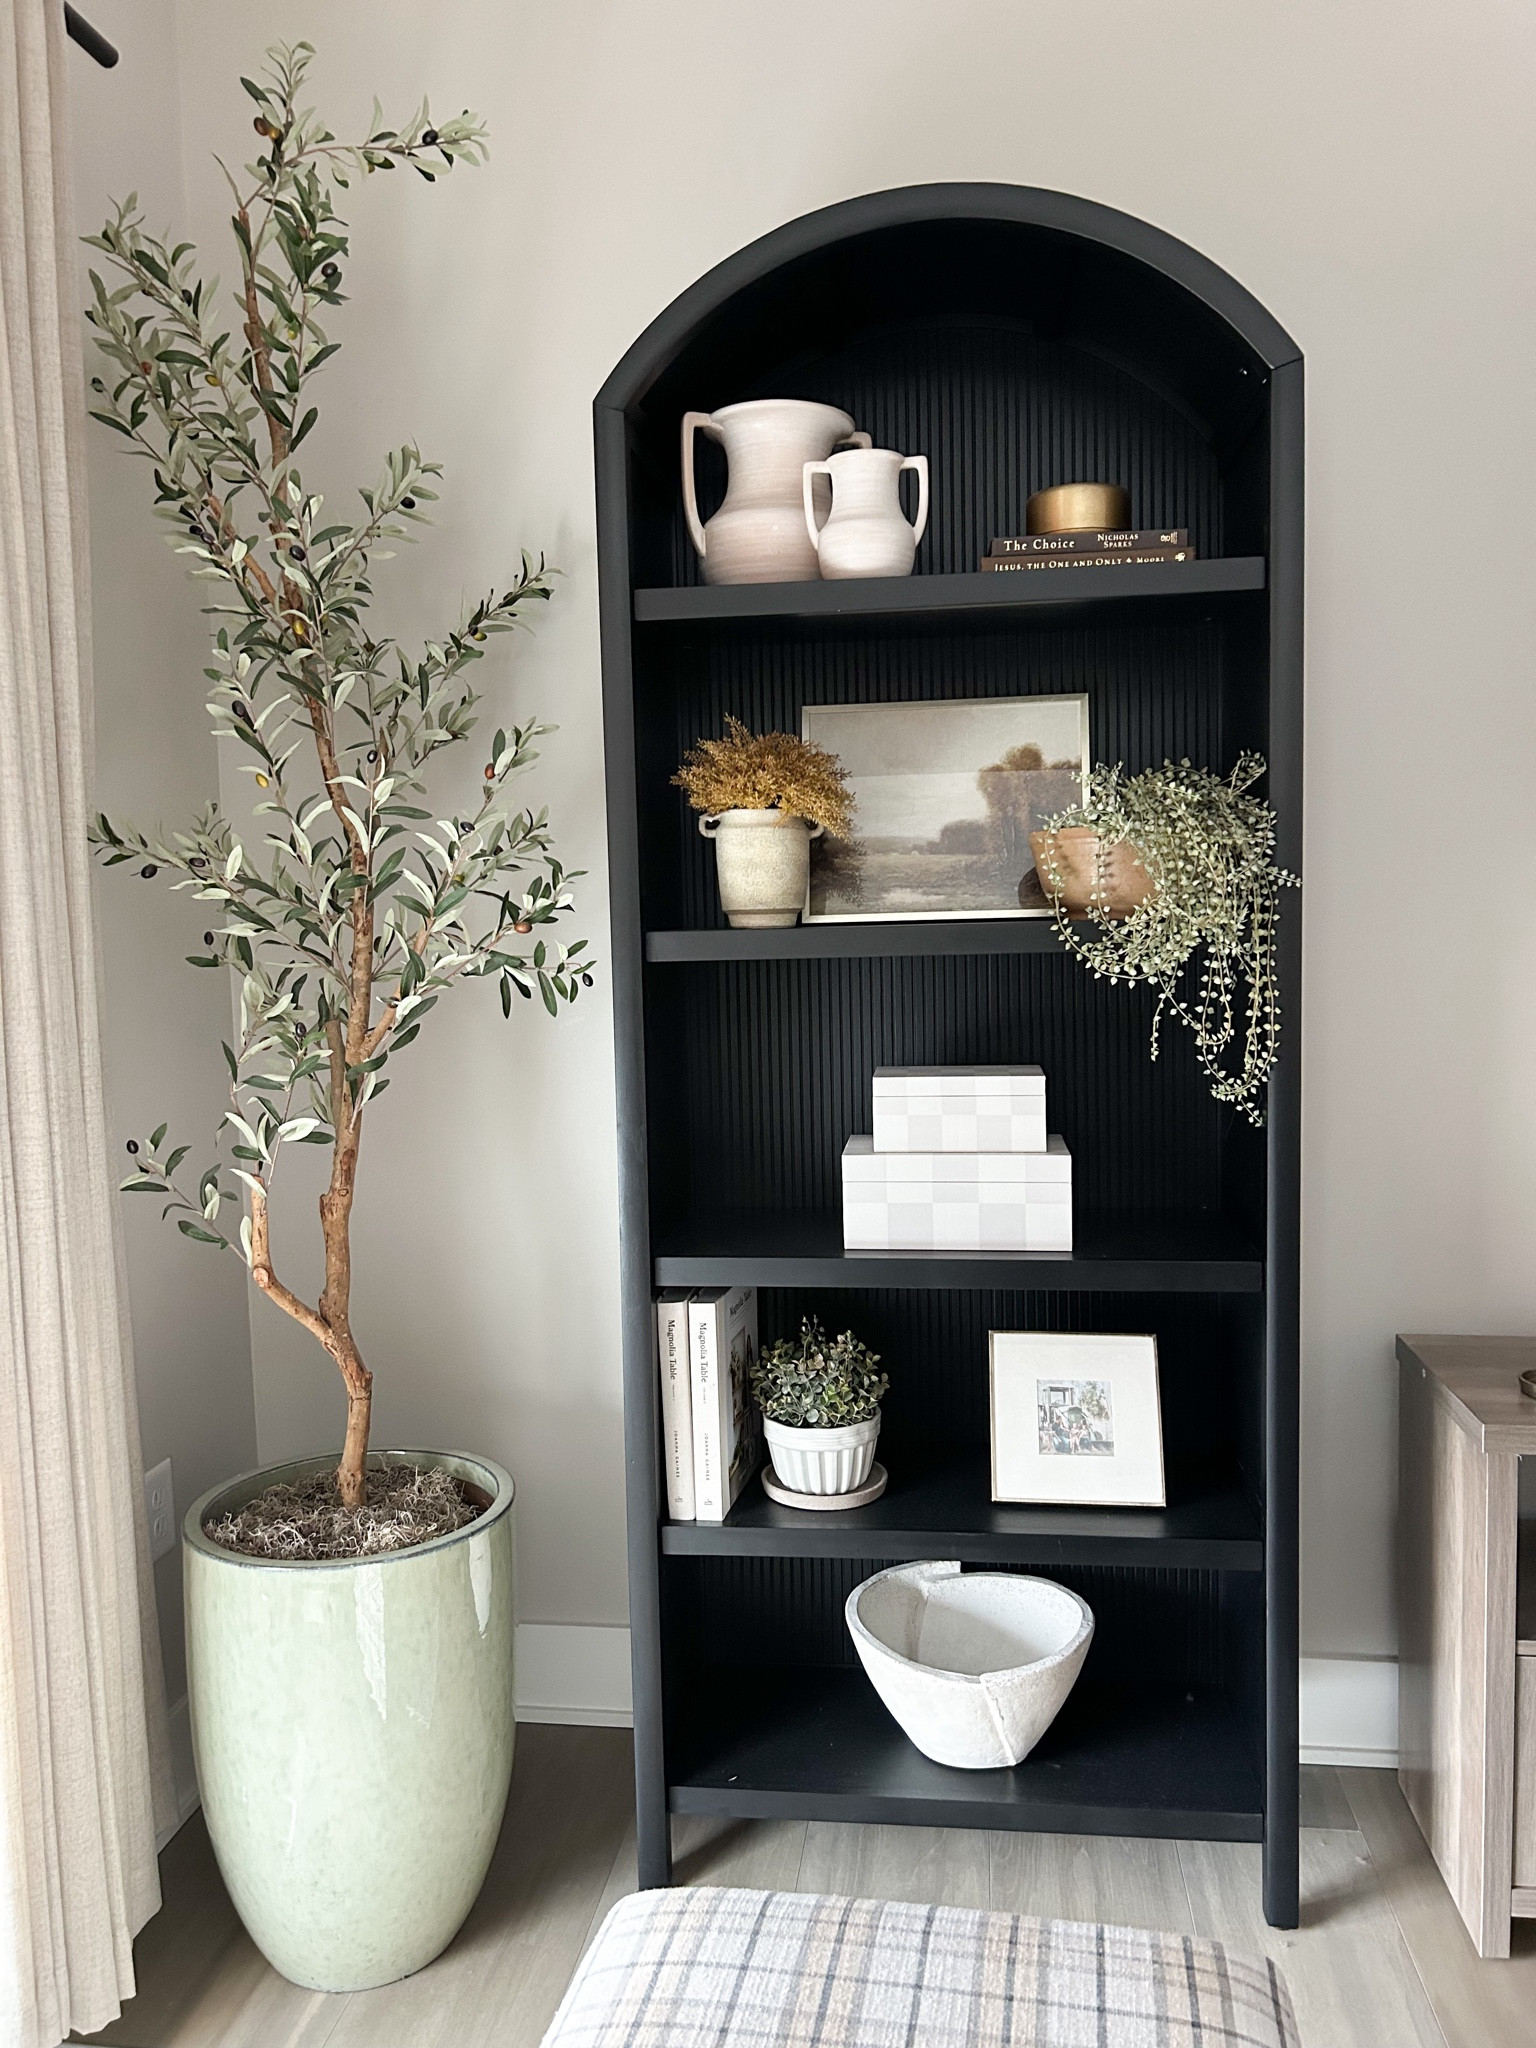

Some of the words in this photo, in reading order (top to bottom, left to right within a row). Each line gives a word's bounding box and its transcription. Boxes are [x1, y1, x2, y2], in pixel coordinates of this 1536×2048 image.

[1004, 540, 1027, 551] The
[1033, 538, 1075, 550] Choice
[1097, 533, 1139, 541] NICHOLAS
[1103, 540, 1132, 548] SPARKS
[1027, 562, 1045, 570] THE
[1049, 560, 1070, 568] ONE
[1073, 559, 1093, 567] AND
[1095, 558, 1122, 566] ONLY
[667, 1320, 676, 1357] Magnolia
[699, 1322, 708, 1359] Magnolia
[669, 1358, 677, 1380] Table
[700, 1362, 709, 1383] Table
